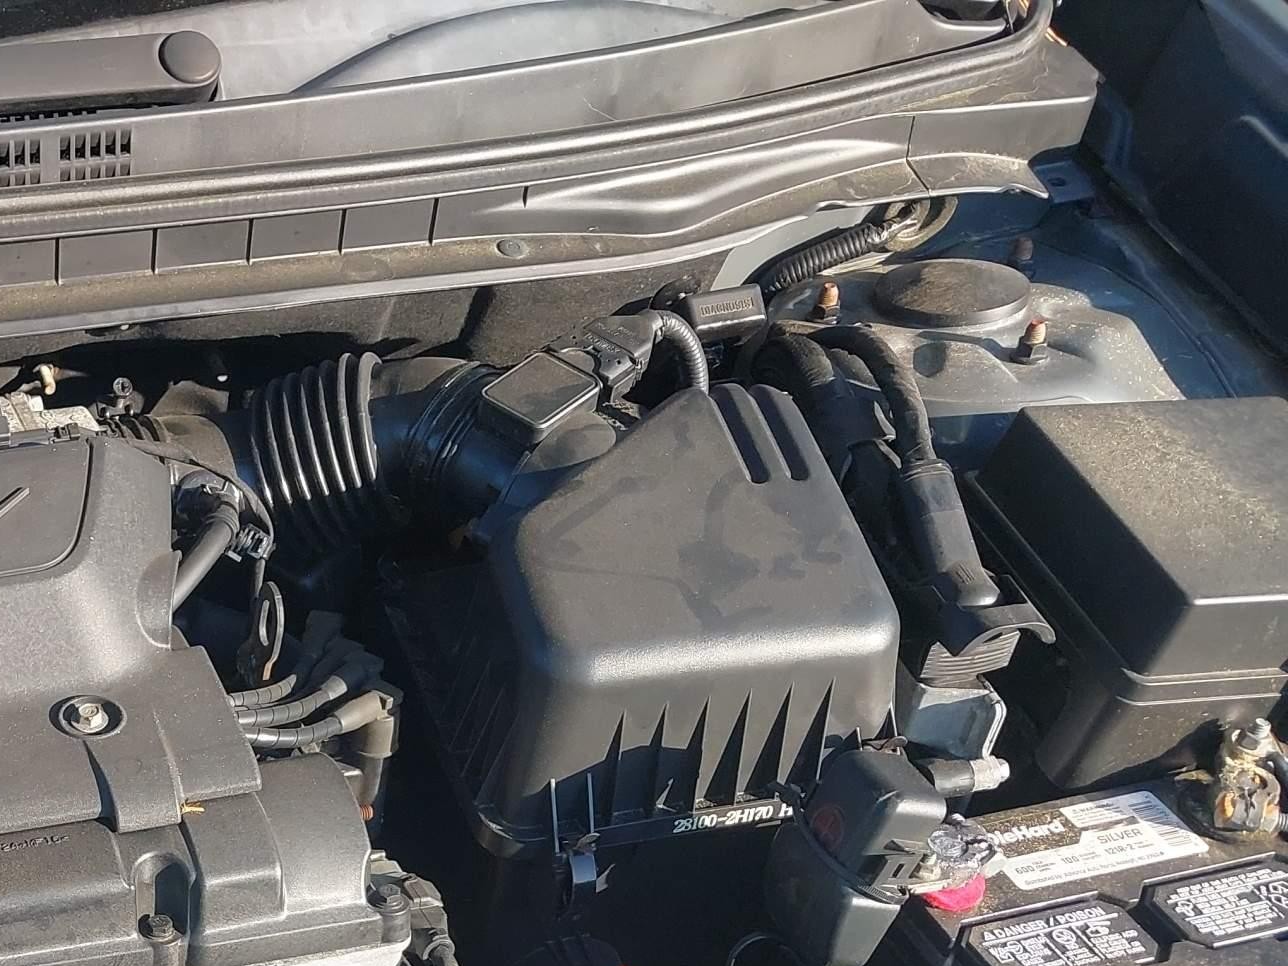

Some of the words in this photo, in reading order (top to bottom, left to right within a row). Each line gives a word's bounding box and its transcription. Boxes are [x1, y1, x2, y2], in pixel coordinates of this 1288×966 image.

[672, 806, 773, 833] 28100-2H170
[1097, 828, 1143, 845] SILVER
[993, 919, 1048, 939] DANGER
[1056, 906, 1106, 925] POISON
